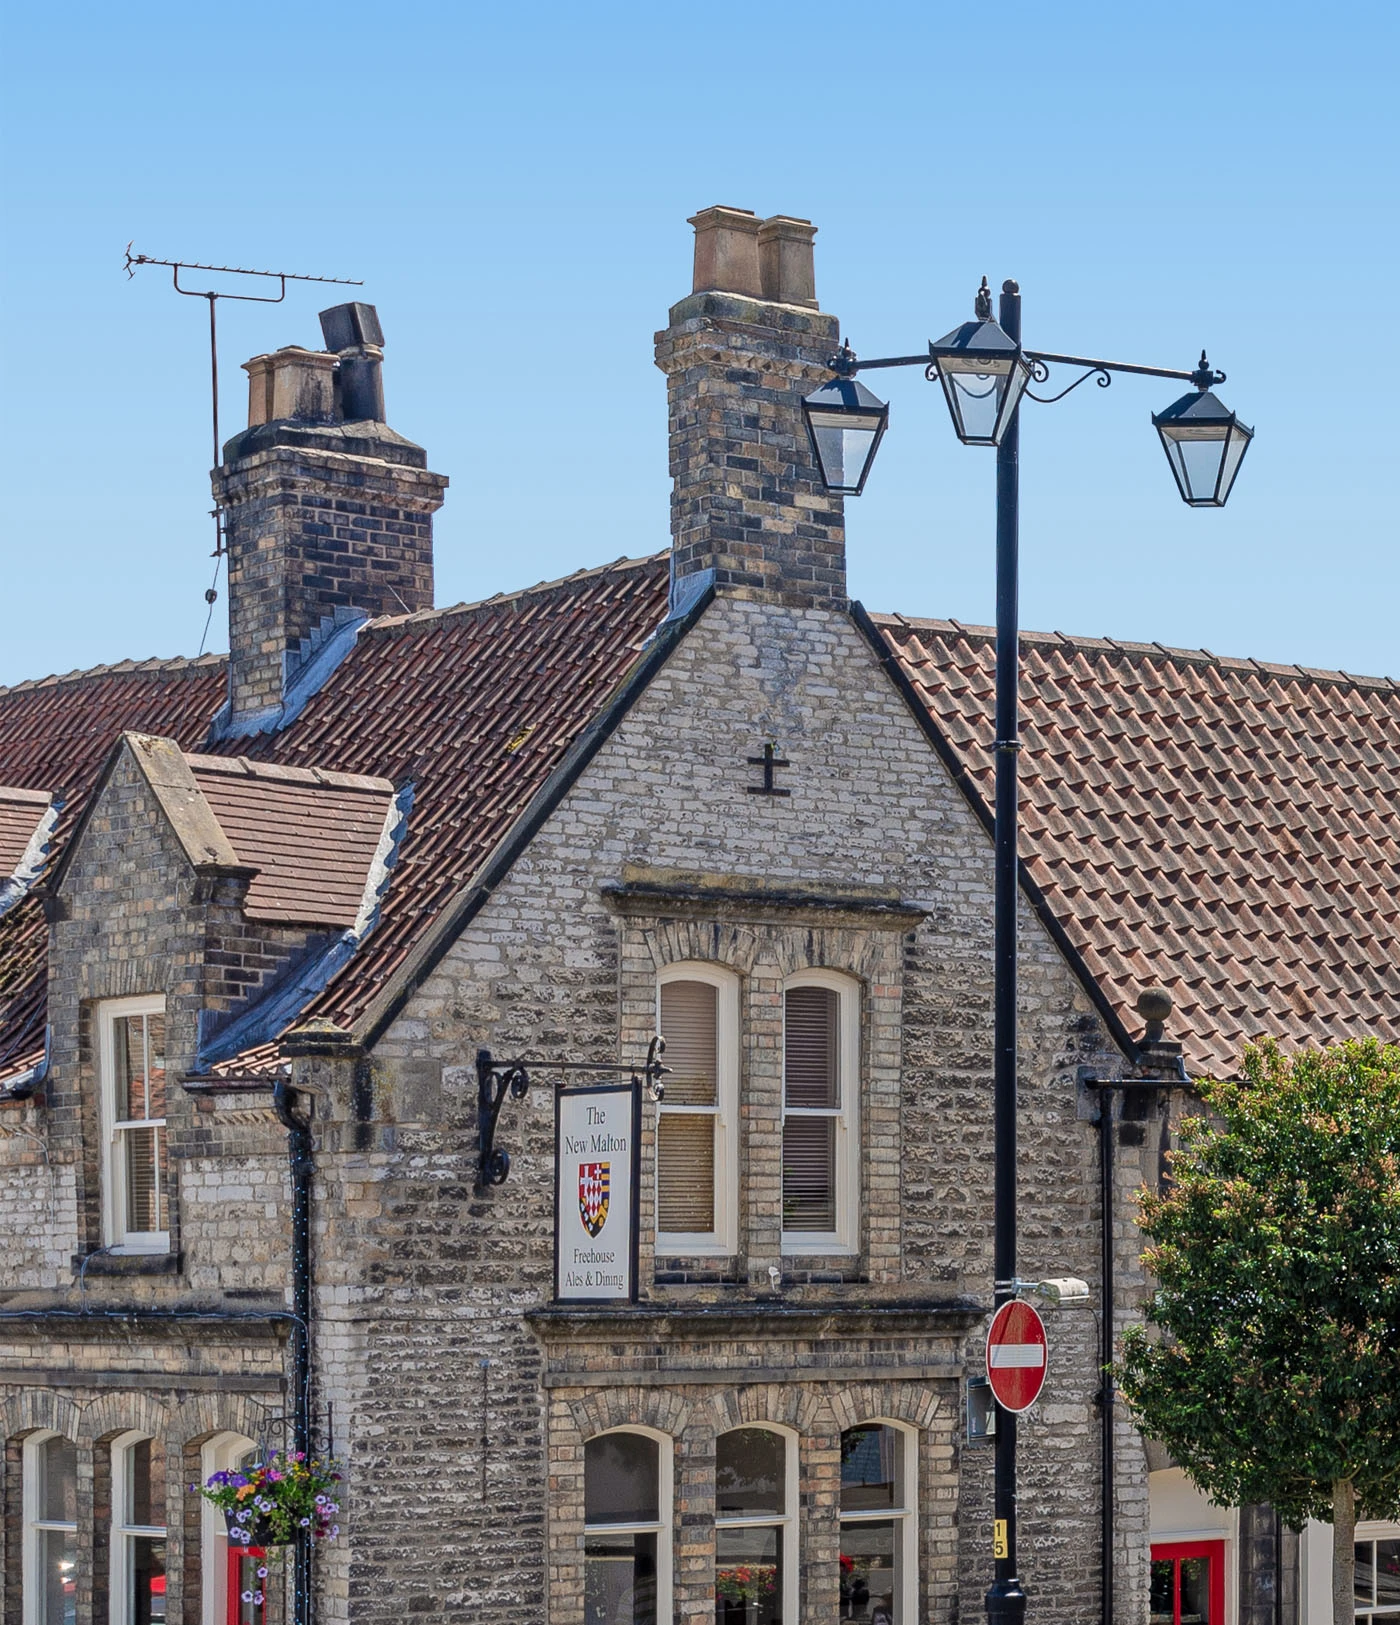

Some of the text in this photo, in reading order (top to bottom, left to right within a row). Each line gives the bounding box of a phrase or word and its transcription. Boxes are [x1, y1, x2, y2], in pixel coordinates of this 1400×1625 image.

[586, 1106, 606, 1126] The
[565, 1133, 627, 1155] New Malton
[573, 1248, 615, 1264] Freehouse
[565, 1270, 624, 1291] Ales & Dining
